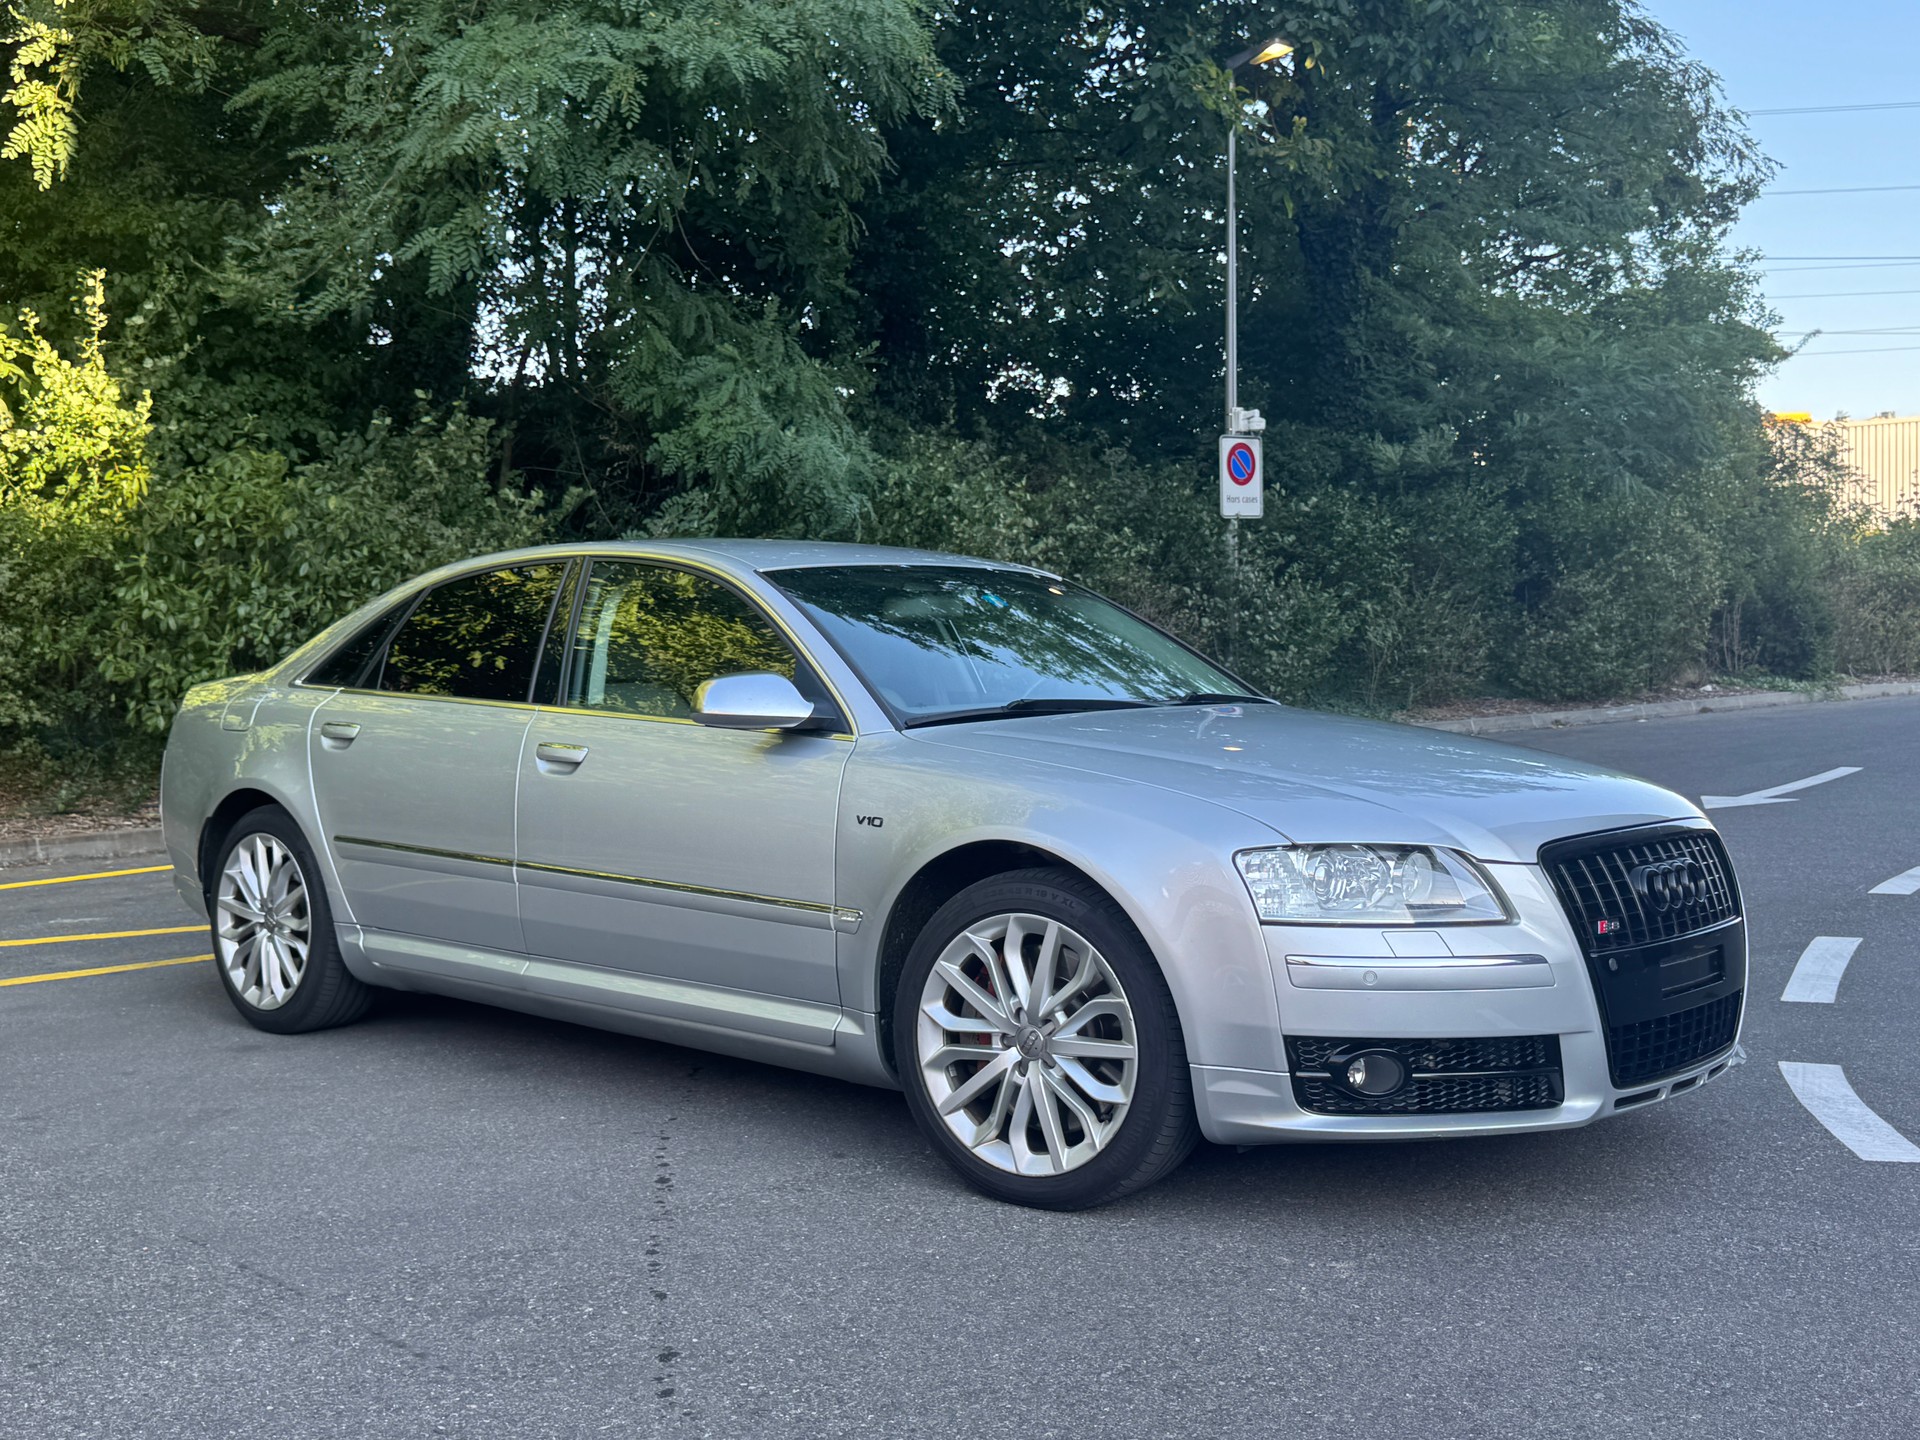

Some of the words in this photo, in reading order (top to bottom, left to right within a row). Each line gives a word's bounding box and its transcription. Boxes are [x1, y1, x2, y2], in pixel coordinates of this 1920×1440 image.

[1226, 494, 1240, 504] Hors
[1241, 495, 1258, 504] cases
[856, 814, 884, 828] V10
[1061, 897, 1075, 909] XL
